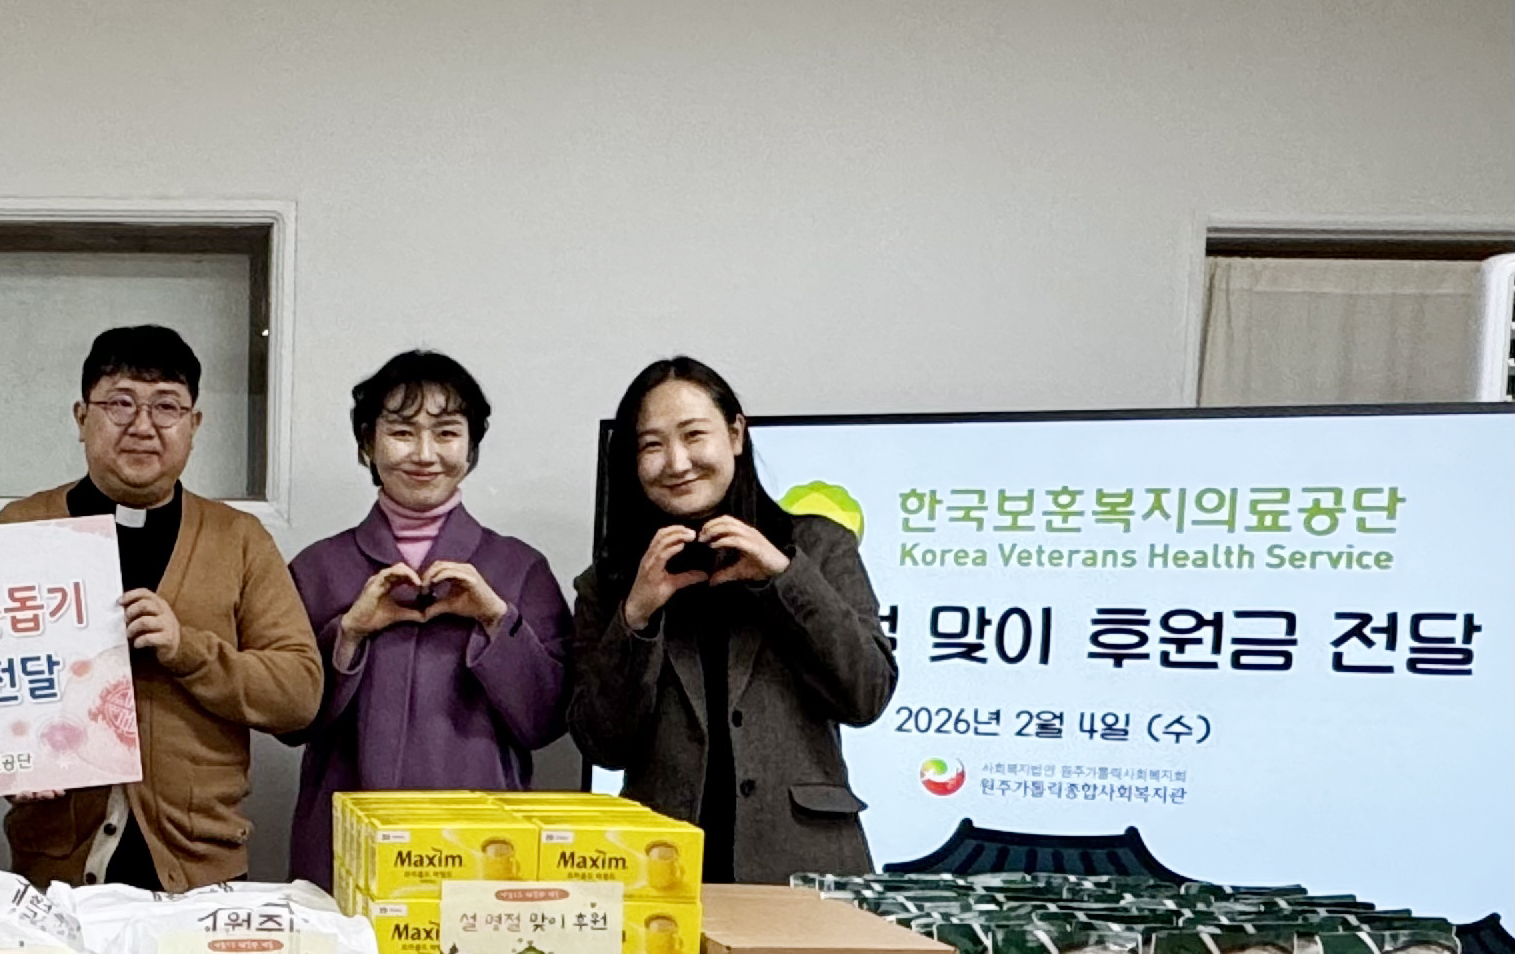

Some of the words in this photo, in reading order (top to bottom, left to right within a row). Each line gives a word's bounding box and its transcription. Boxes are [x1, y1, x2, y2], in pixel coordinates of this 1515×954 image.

[899, 486, 1406, 536] 한국보훈복지의료공단
[900, 543, 987, 567] Korea
[998, 543, 1137, 569] Veterans
[1148, 543, 1254, 569] Health
[1266, 544, 1394, 570] Service
[929, 605, 1052, 665] 맞이
[1087, 607, 1298, 671] 후원금
[1330, 611, 1482, 676] 전달
[895, 706, 1001, 737] 2026년
[1015, 710, 1064, 739] 2월
[1080, 711, 1131, 742] 4일
[1147, 712, 1212, 745] (수)
[394, 847, 463, 868] Maxim
[556, 848, 627, 870] Maxim
[391, 920, 441, 941] Maxi
[459, 912, 479, 932] 설
[485, 912, 522, 932] 명절
[529, 912, 565, 932] 맞이
[572, 912, 609, 932] 후원
